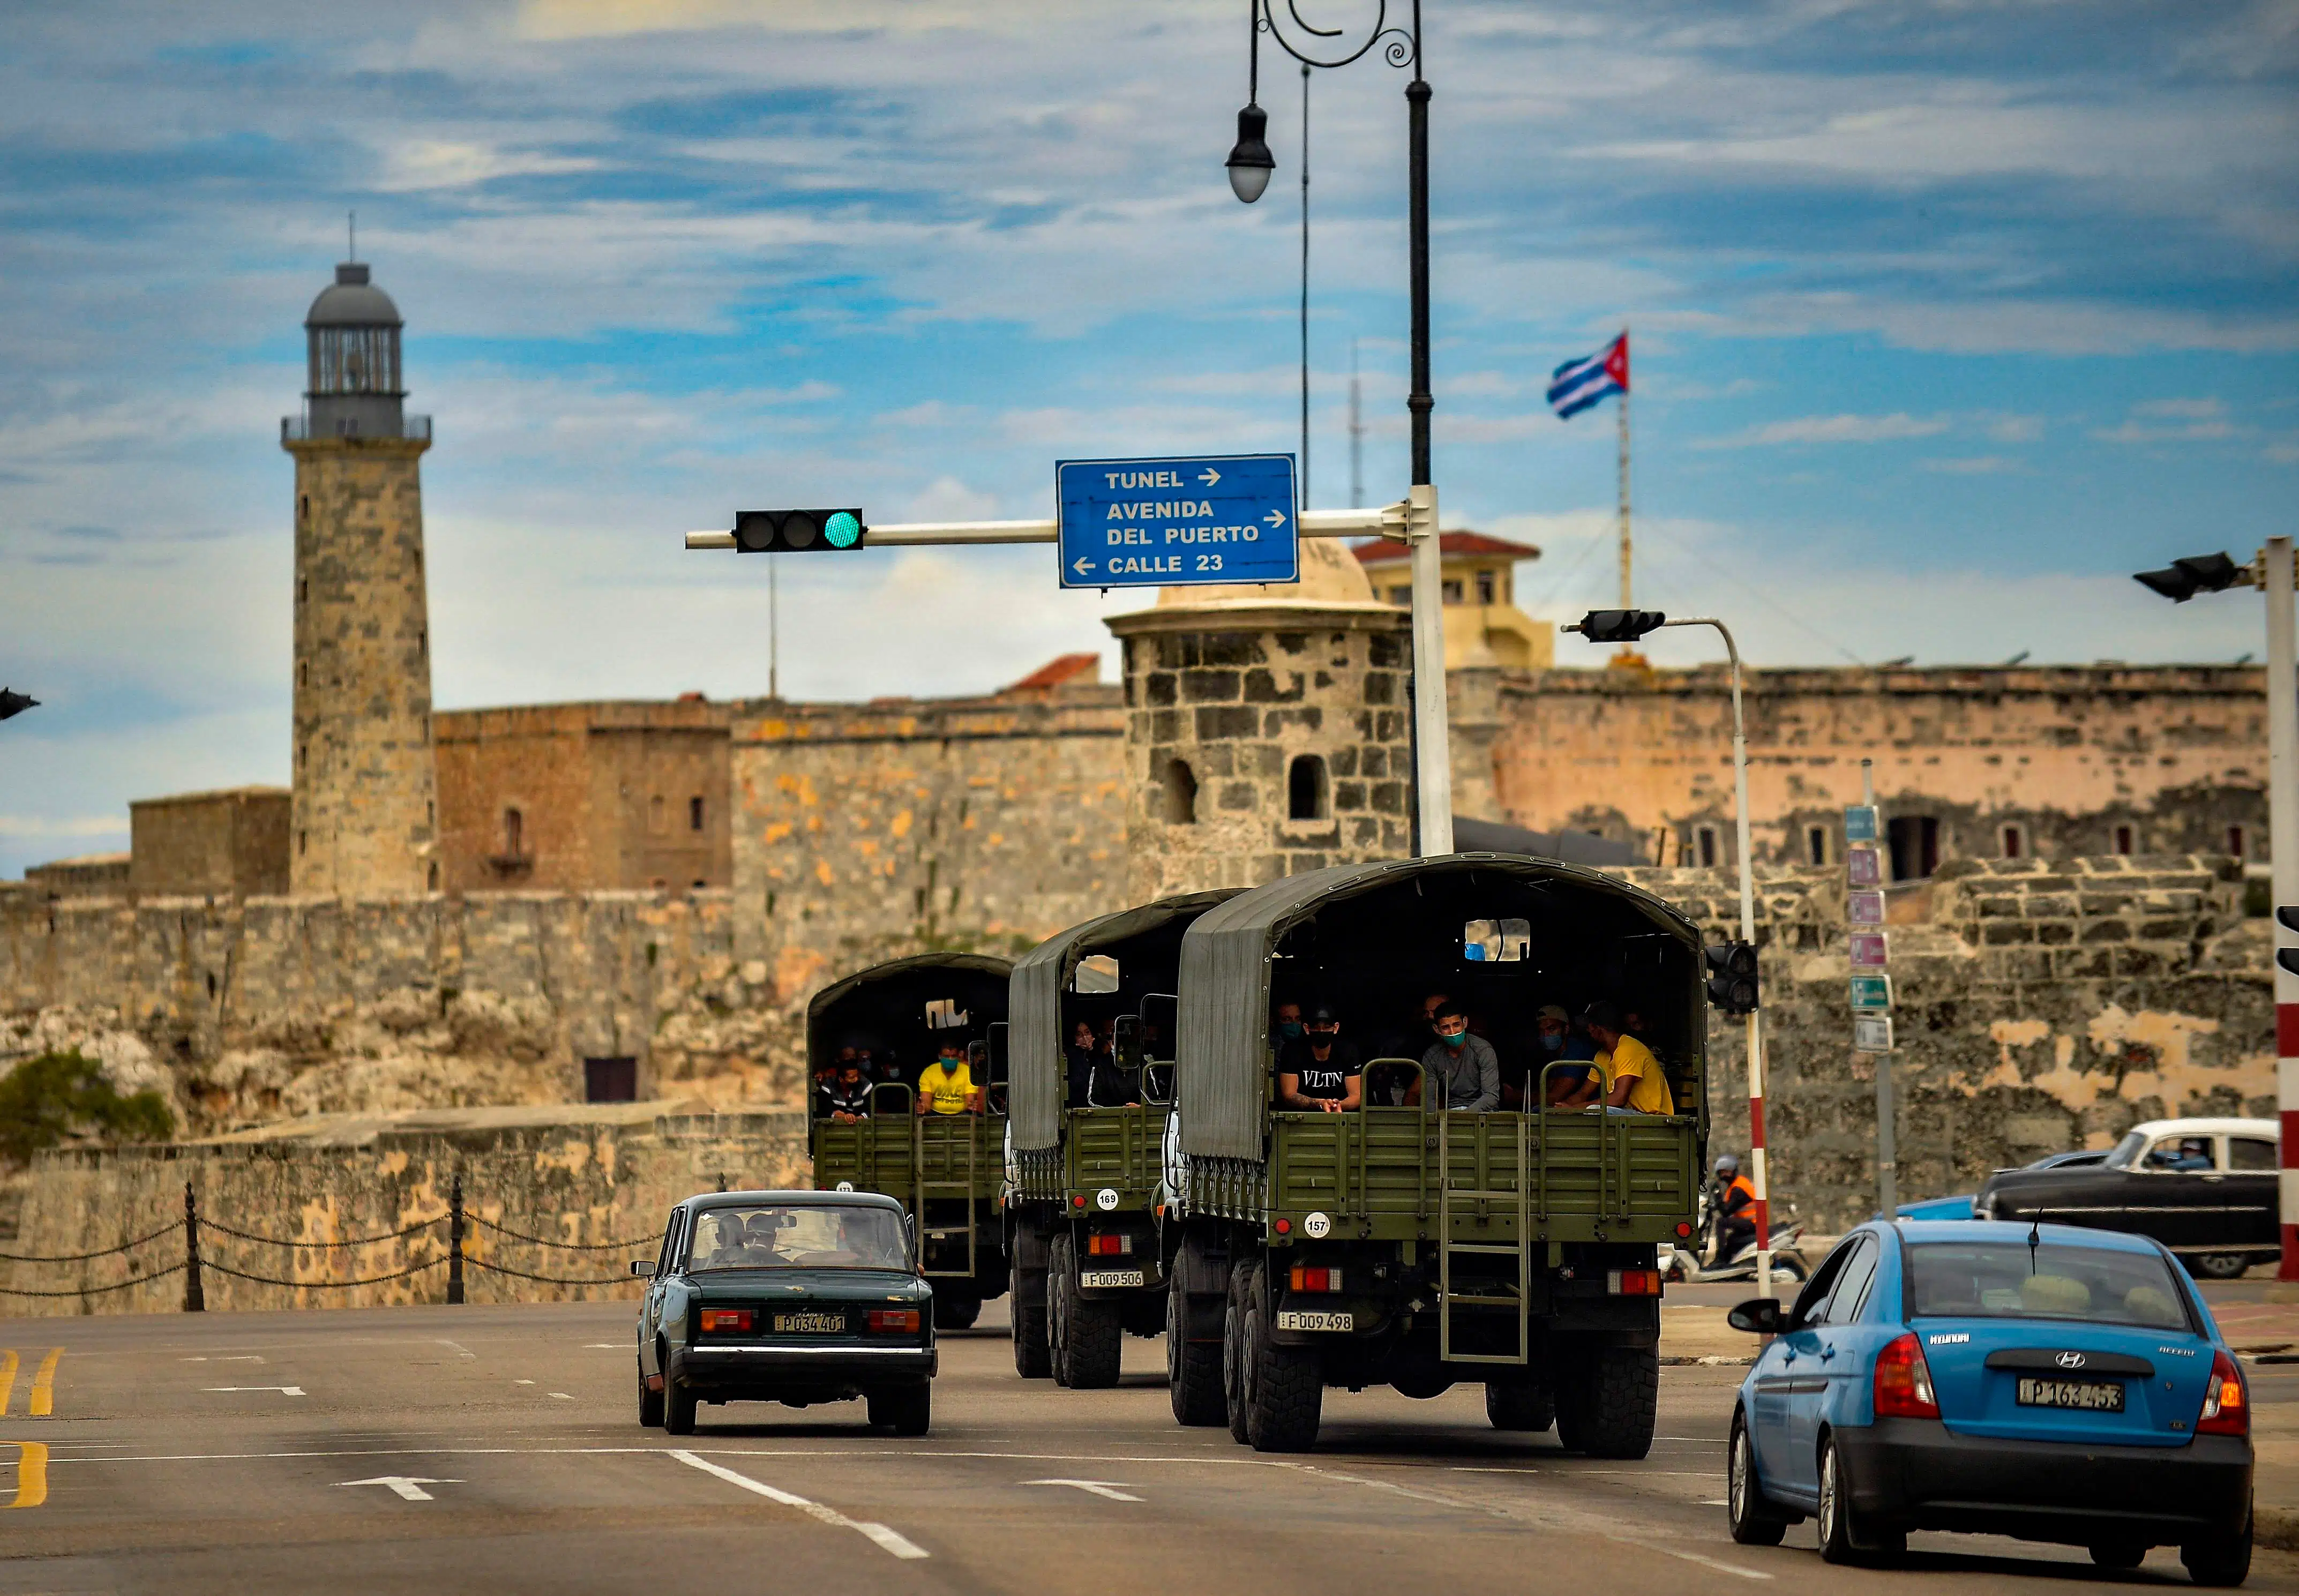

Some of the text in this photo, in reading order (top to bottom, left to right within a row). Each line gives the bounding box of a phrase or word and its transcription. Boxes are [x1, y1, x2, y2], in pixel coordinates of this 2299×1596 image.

[1105, 471, 1184, 489] TUNEL
[1106, 500, 1214, 519] AVENIDA
[1107, 526, 1259, 545] DEL PUERTO
[1109, 555, 1223, 573] CALLE 23
[1302, 1070, 1343, 1087] VLTN
[1099, 1195, 1115, 1204] 169
[1308, 1220, 1326, 1231] 157
[1090, 1274, 1097, 1286] F
[1099, 1273, 1119, 1286] 009
[1121, 1272, 1142, 1285] 506
[784, 1316, 791, 1331] P
[794, 1316, 818, 1331] 034
[1289, 1314, 1351, 1329] F 009 498
[1930, 1333, 1970, 1345] HYUNDAI
